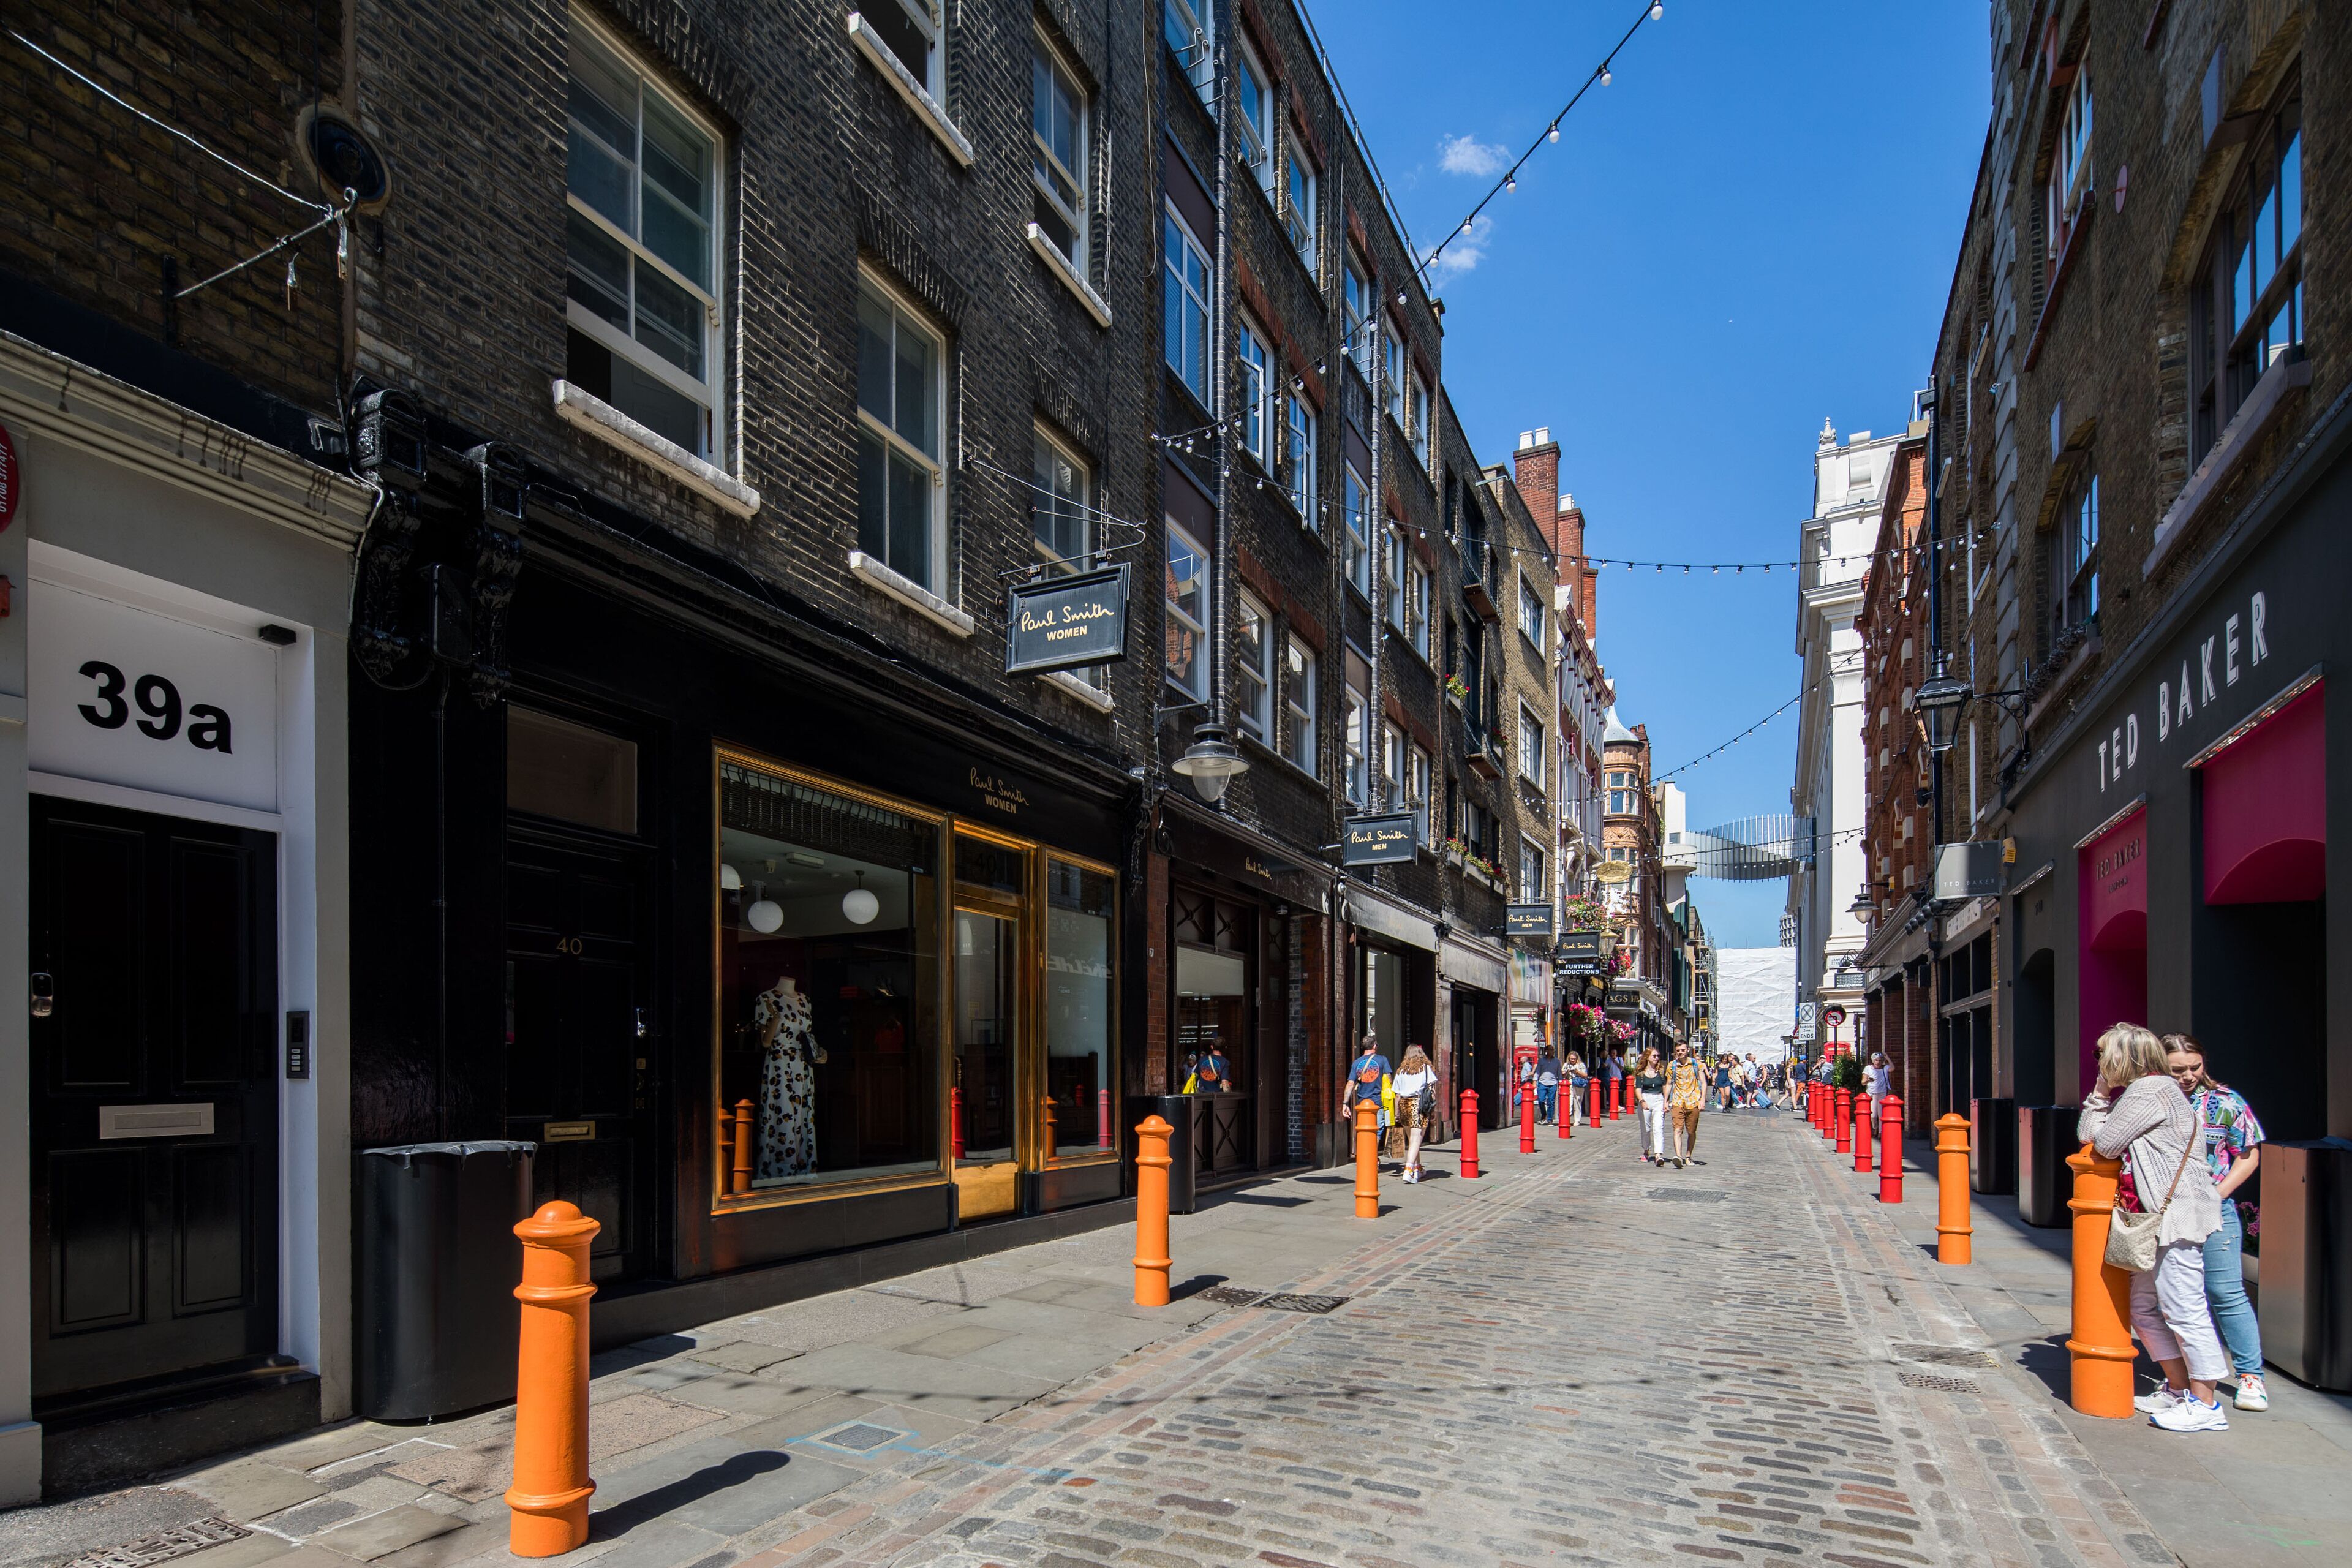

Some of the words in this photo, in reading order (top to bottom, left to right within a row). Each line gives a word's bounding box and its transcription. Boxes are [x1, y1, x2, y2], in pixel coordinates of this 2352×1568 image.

[1021, 611, 1057, 633] Paul
[1063, 603, 1115, 622] Smith
[1047, 627, 1087, 641] WOMEN
[2098, 712, 2139, 793] TED
[2159, 591, 2269, 742] BAKER
[78, 660, 233, 755] 39a
[971, 767, 994, 791] Paul
[998, 780, 1029, 806] Smith
[985, 794, 1017, 814] WOMEN
[1351, 832, 1373, 843] Paul
[1377, 829, 1409, 840] Smith
[2097, 858, 2109, 881] TED
[2114, 838, 2140, 870] BAKER
[556, 937, 582, 955] 40
